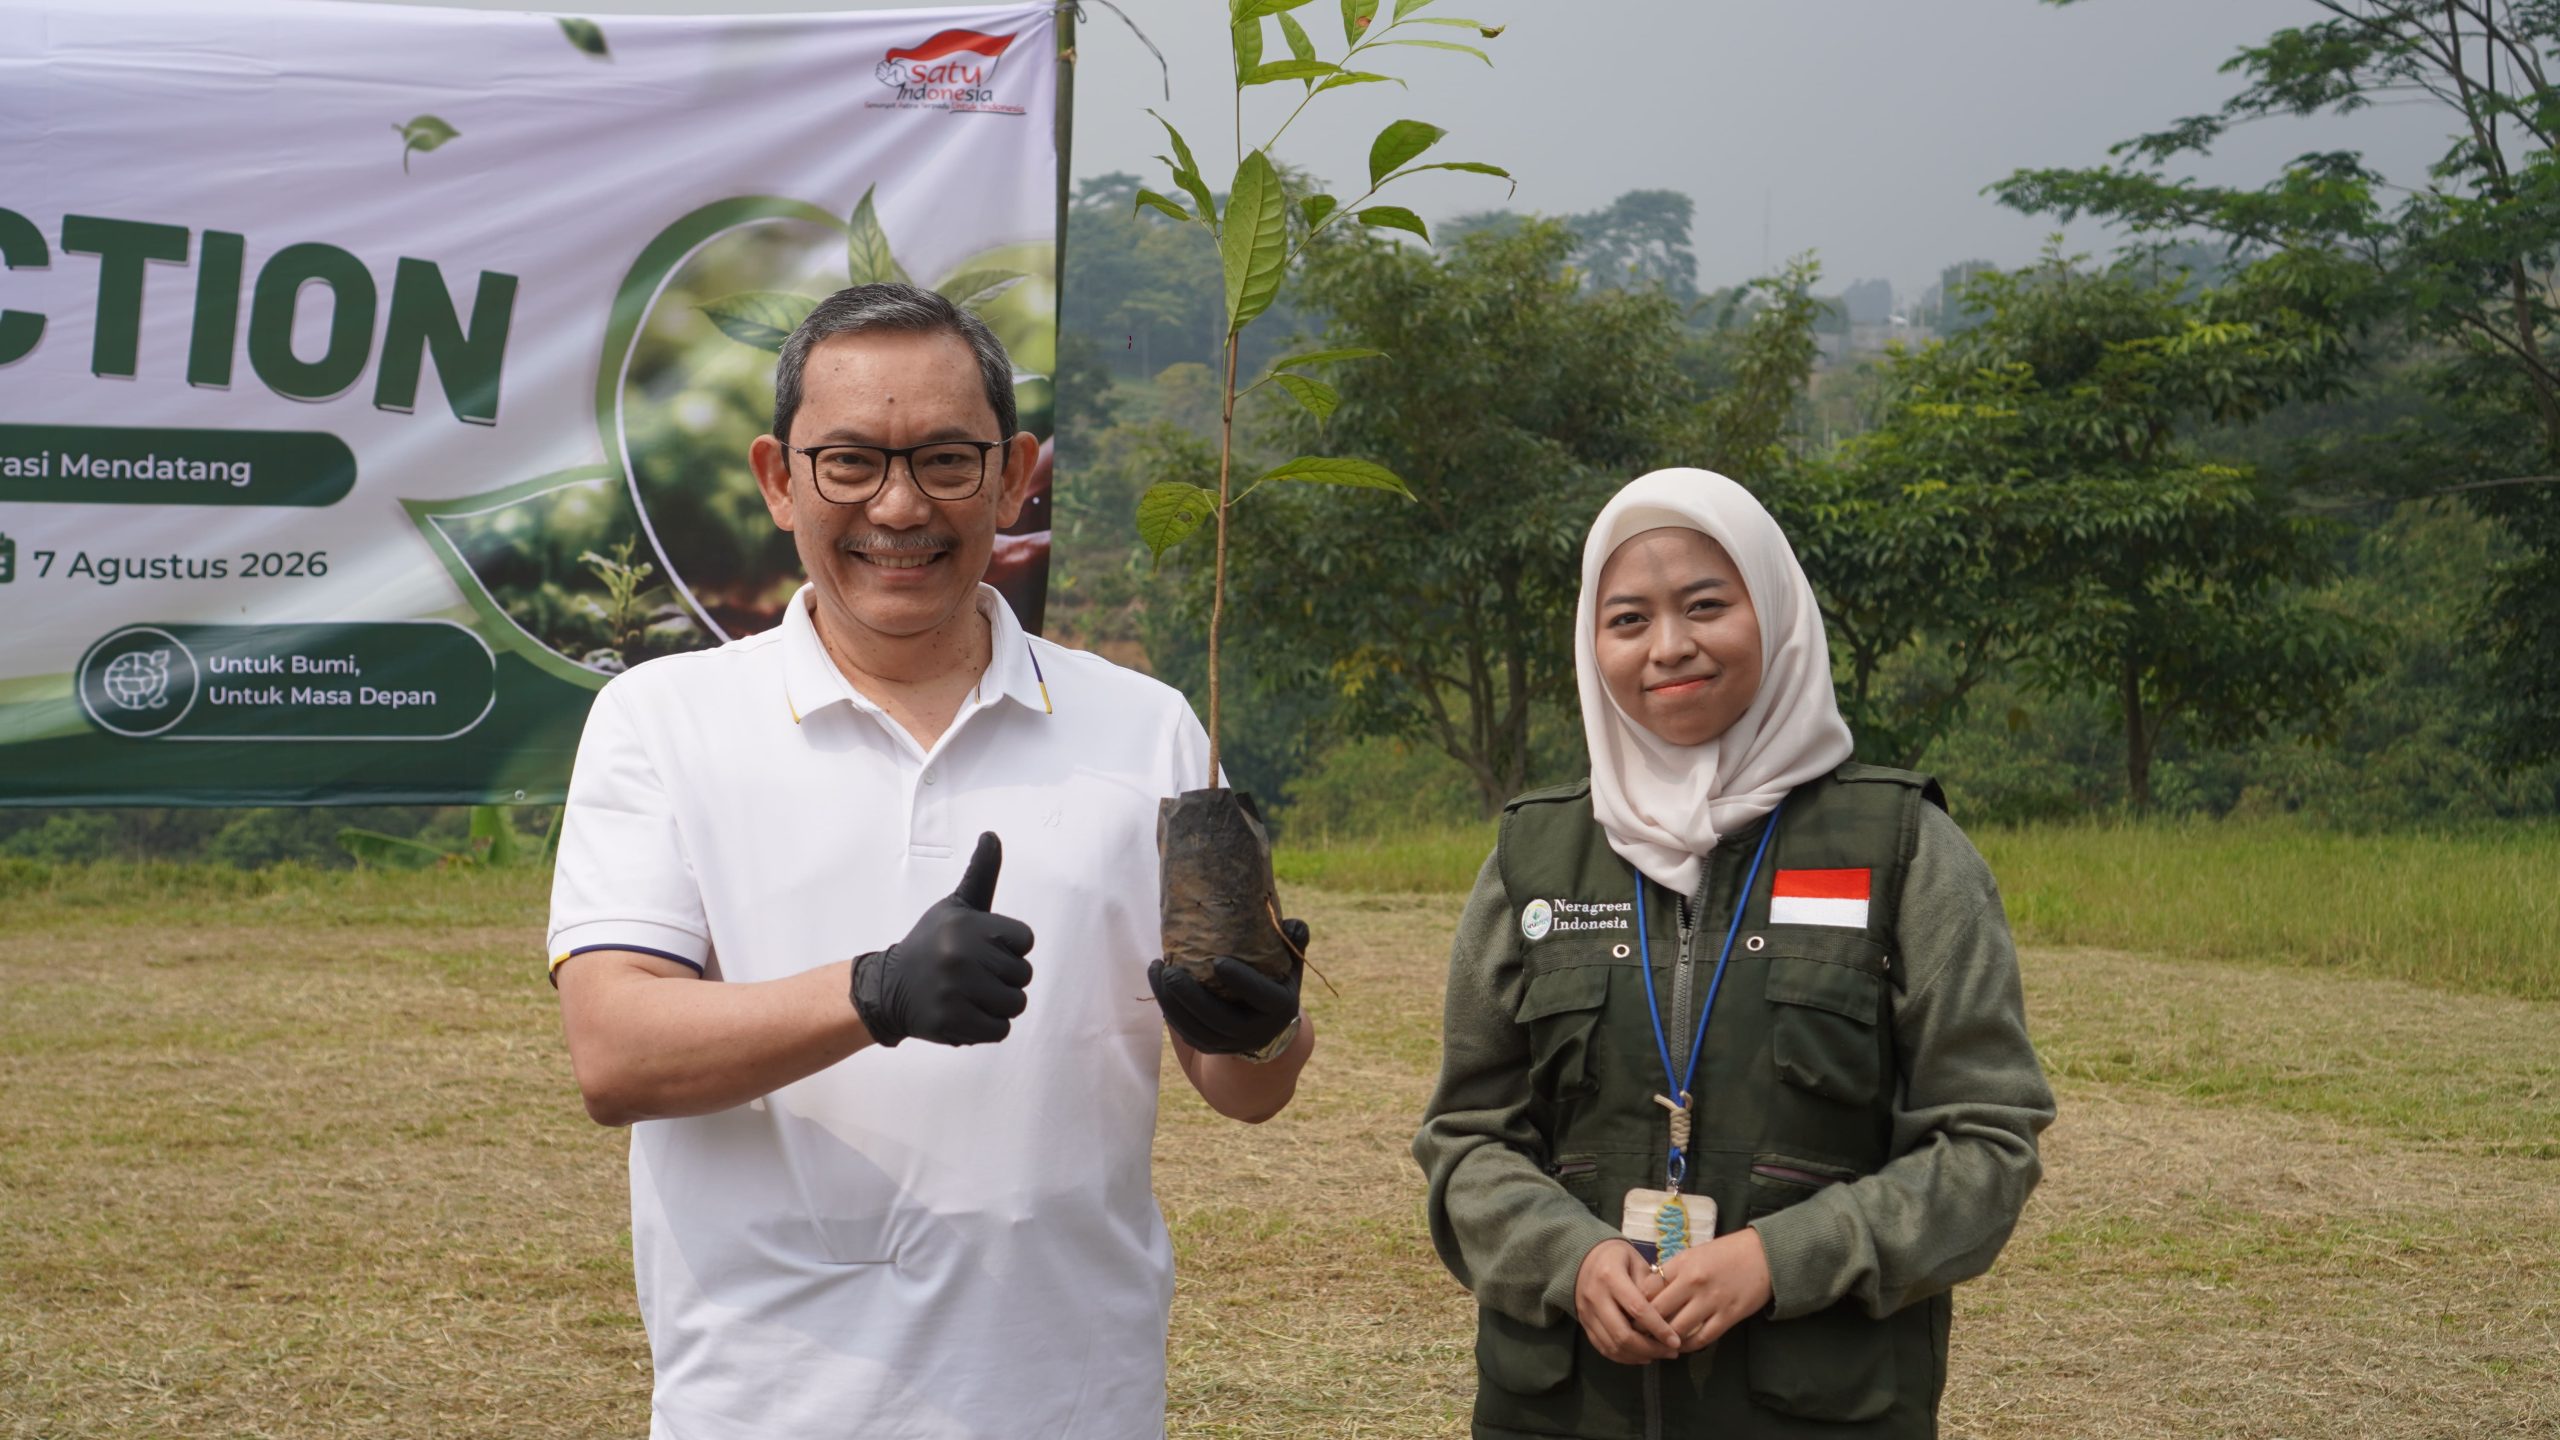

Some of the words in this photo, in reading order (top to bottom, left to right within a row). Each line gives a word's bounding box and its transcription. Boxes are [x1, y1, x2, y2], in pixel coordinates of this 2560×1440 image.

[896, 83, 993, 101] Indonesia
[0, 450, 49, 477] asi
[61, 452, 252, 486] Mendatang
[33, 551, 56, 579] 7
[67, 551, 228, 586] Agustus
[239, 551, 328, 578] 2026
[209, 655, 284, 674] Untuk
[291, 654, 361, 677] Bumi,
[209, 686, 284, 705] Untuk
[291, 686, 352, 705] Masa
[359, 686, 437, 709] Depan
[1553, 898, 1632, 916] Neragreen
[1553, 916, 1629, 931] Indonesia
